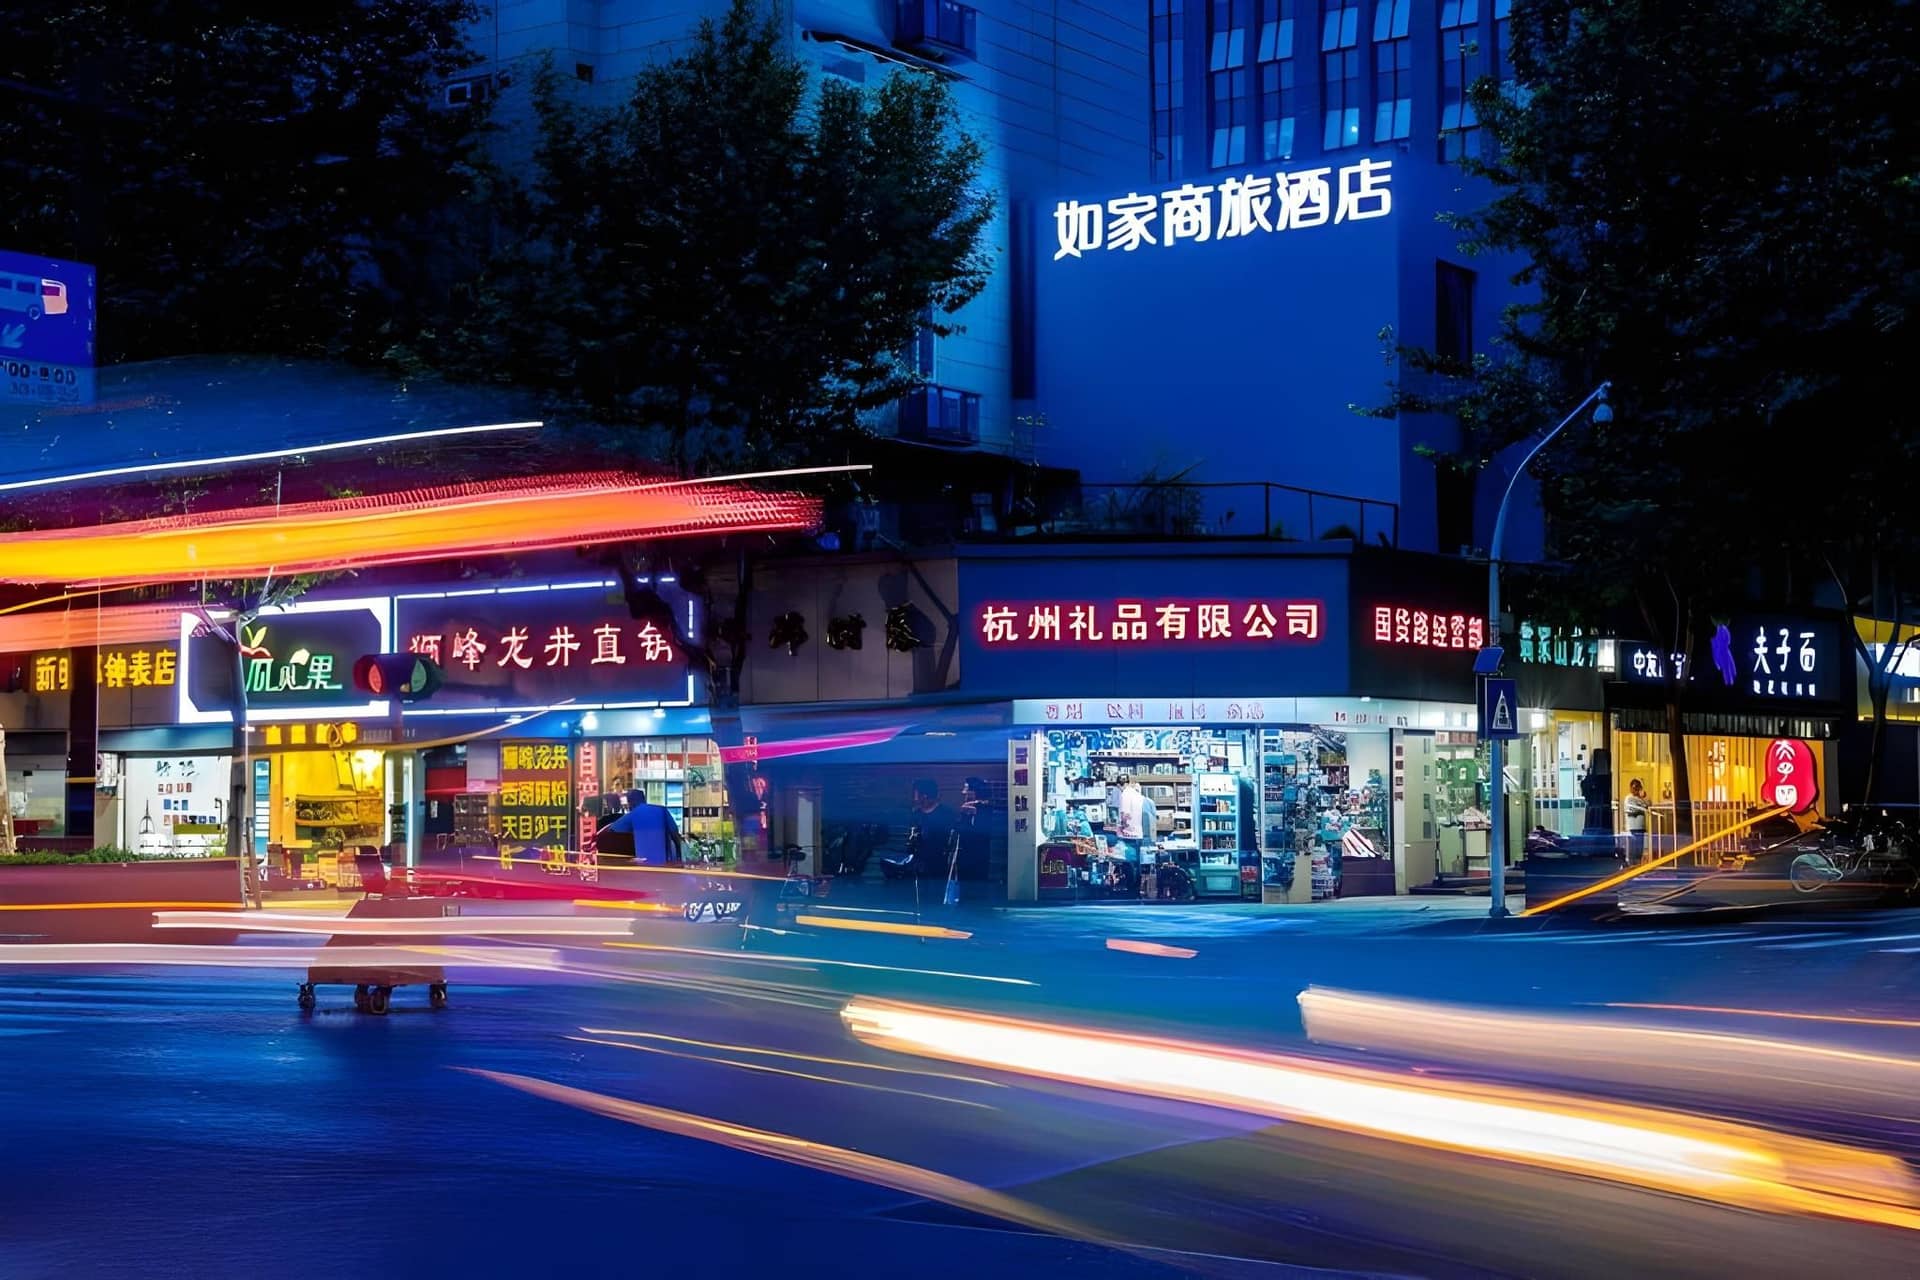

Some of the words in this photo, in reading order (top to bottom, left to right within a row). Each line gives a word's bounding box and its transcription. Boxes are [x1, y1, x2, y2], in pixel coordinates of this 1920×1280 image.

[1053, 158, 1393, 261] 如家商旅酒店
[982, 603, 1318, 642] 杭州礼品有限公司
[36, 649, 177, 691] 新钟表店
